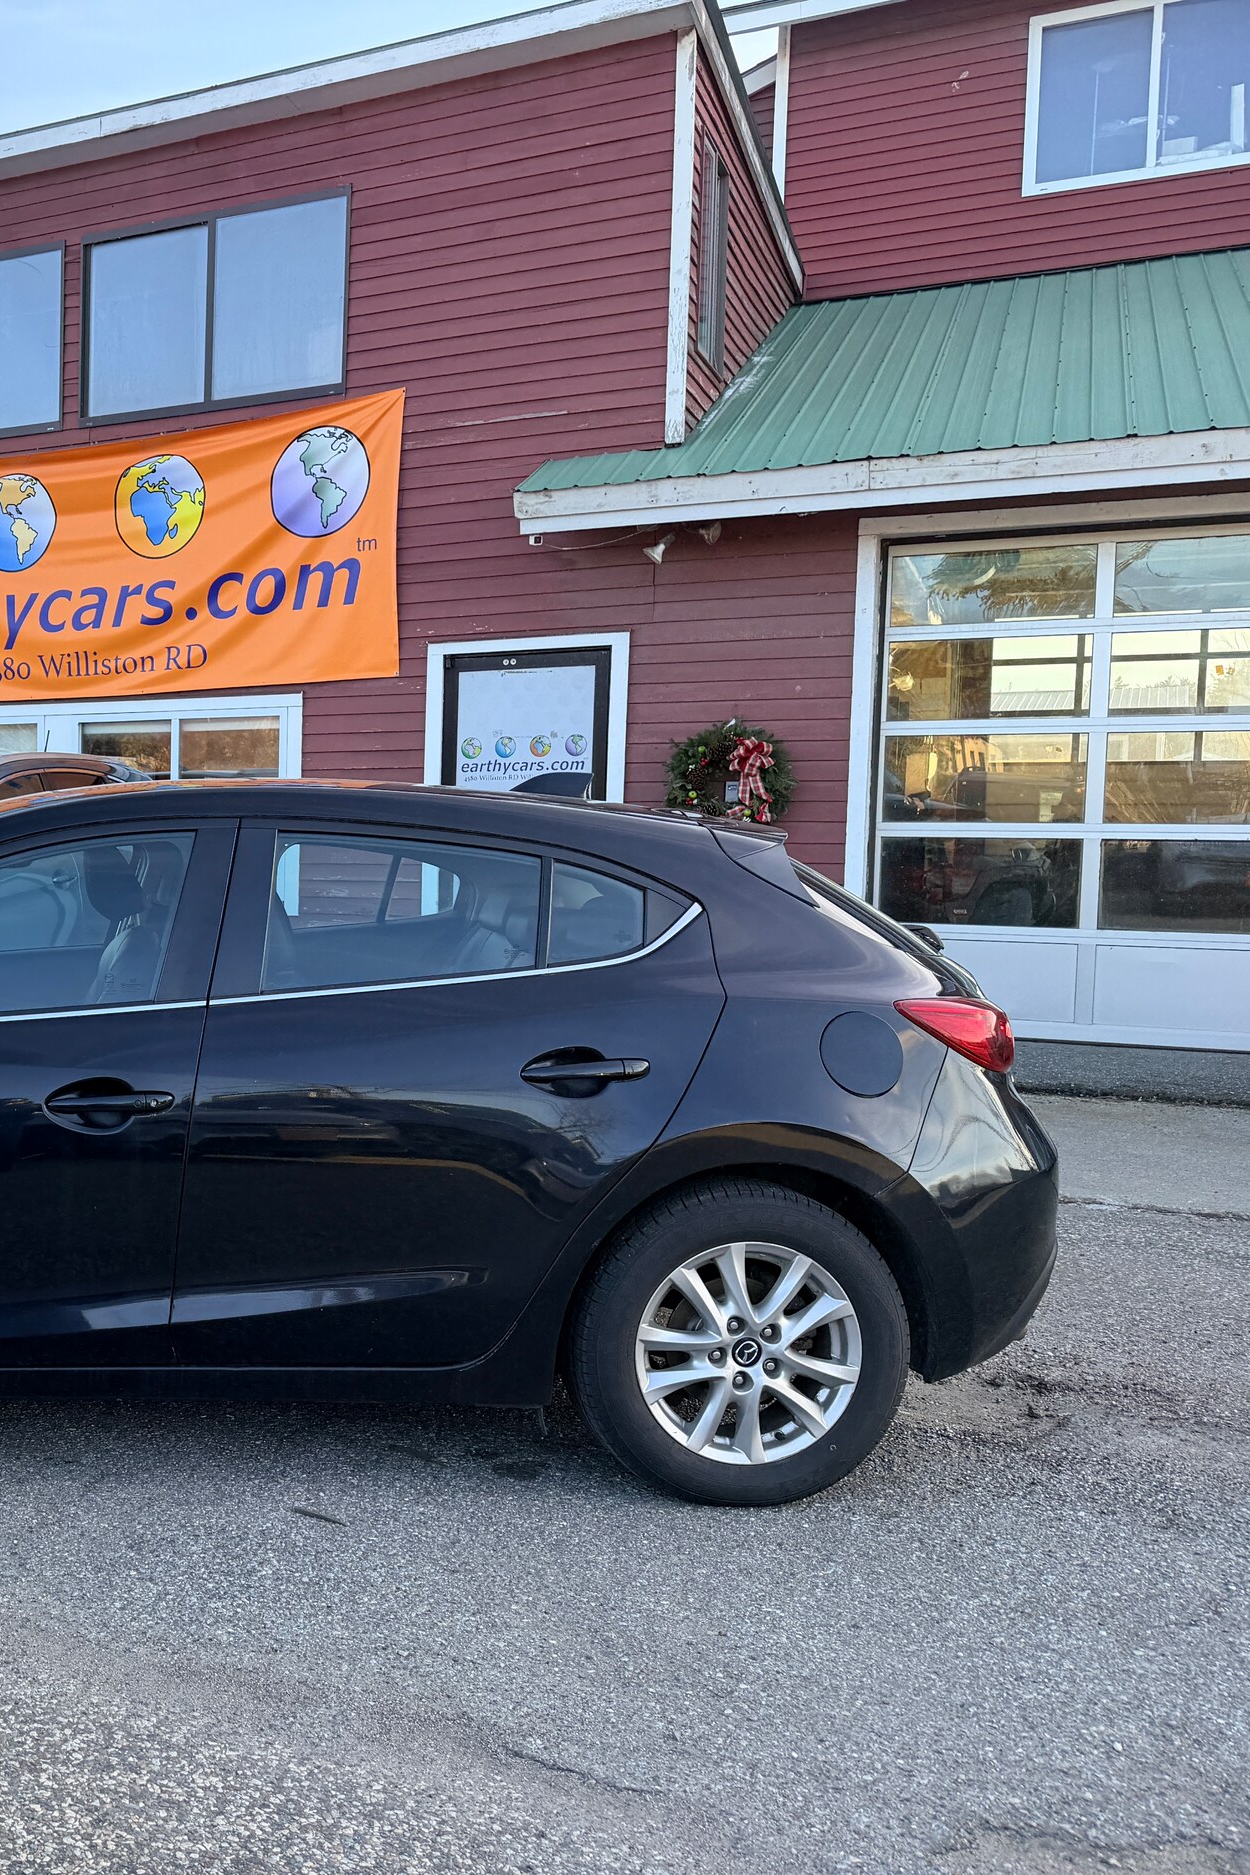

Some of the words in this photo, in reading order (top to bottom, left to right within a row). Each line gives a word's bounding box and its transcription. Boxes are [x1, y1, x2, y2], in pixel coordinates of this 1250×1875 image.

[356, 536, 378, 552] tm
[39, 652, 155, 679] Williston
[165, 644, 208, 670] RD
[461, 759, 585, 775] earthycars.com
